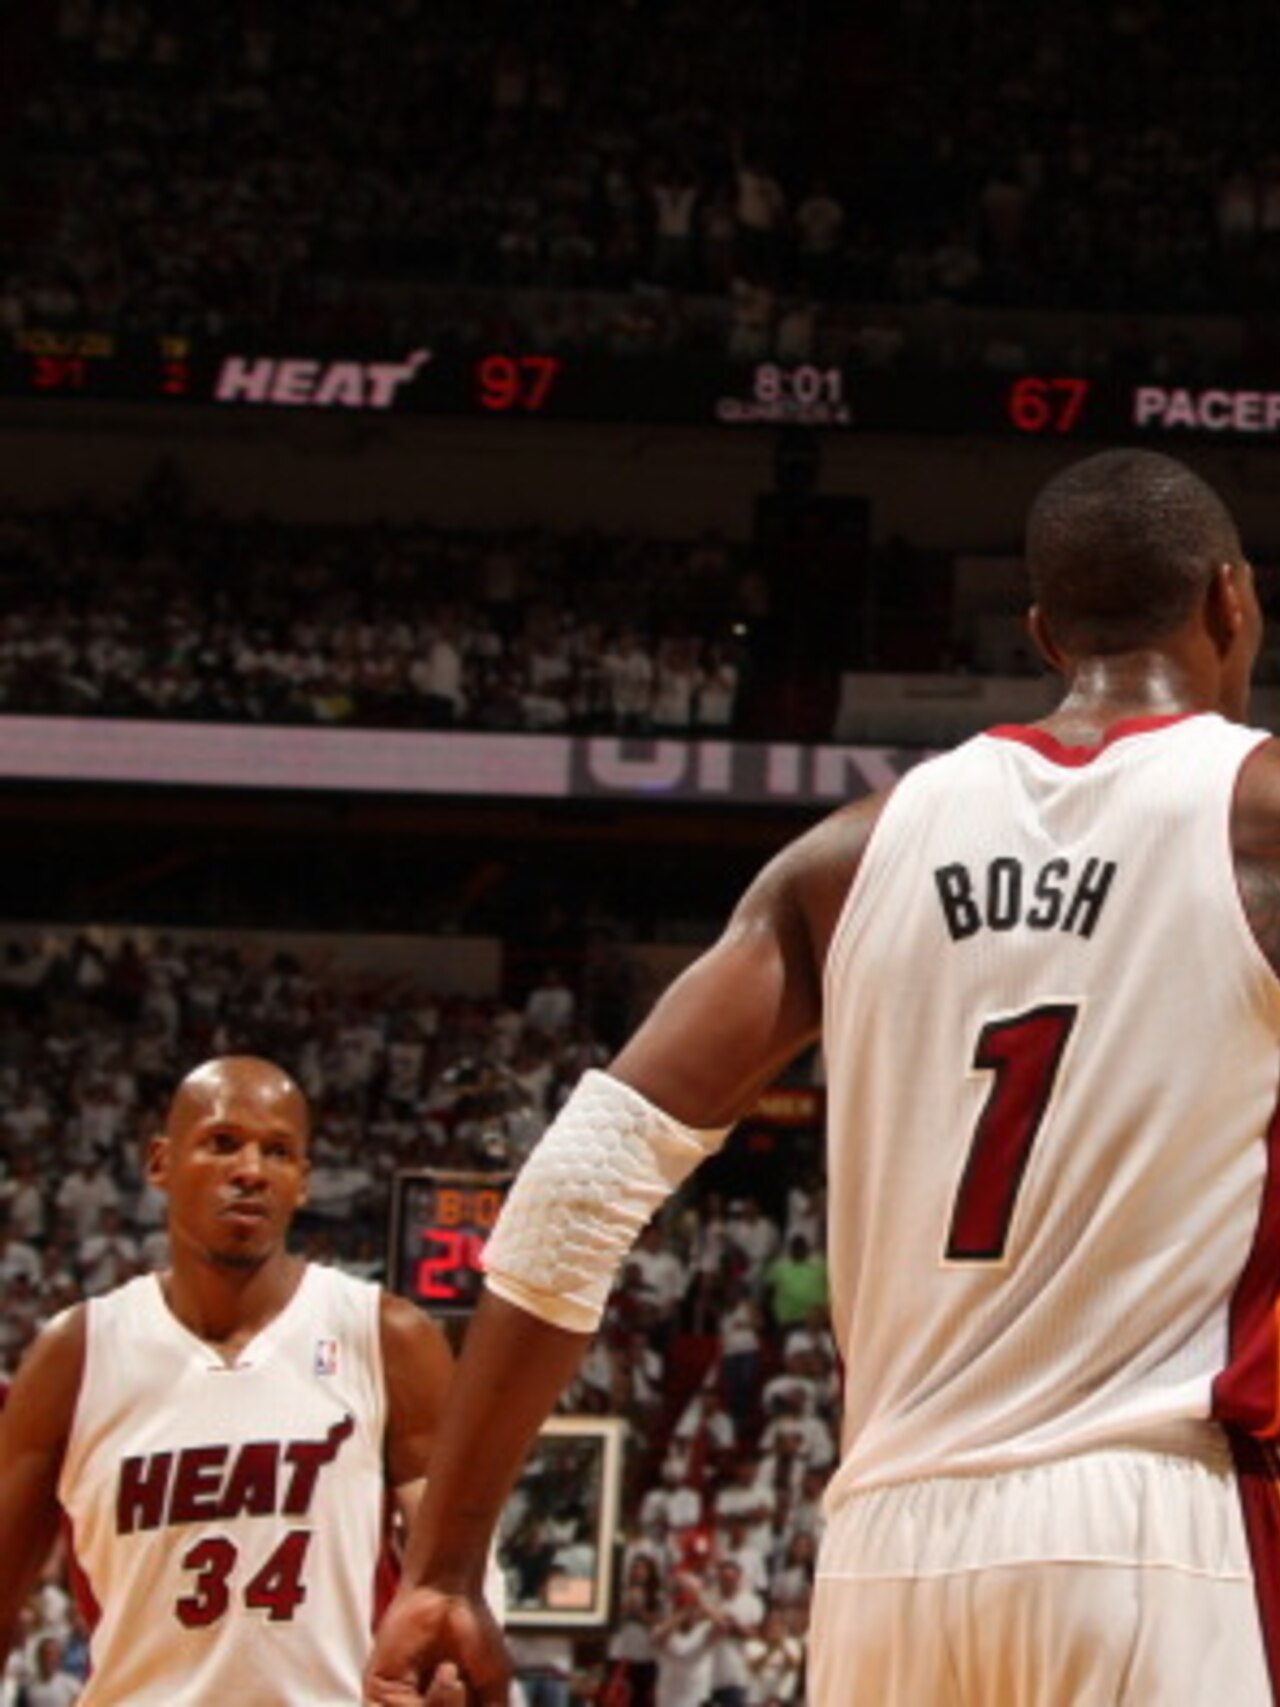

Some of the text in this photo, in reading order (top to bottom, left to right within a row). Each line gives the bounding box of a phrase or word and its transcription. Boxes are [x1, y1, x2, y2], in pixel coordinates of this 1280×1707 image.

[216, 349, 430, 409] HEAT
[477, 355, 559, 411] 97
[752, 367, 845, 405] 8:01
[1008, 377, 1088, 433] 67
[935, 857, 1118, 943] BOSH
[942, 1003, 1080, 1267] 1
[115, 1412, 354, 1536] HEAT
[176, 1530, 312, 1630] 34
